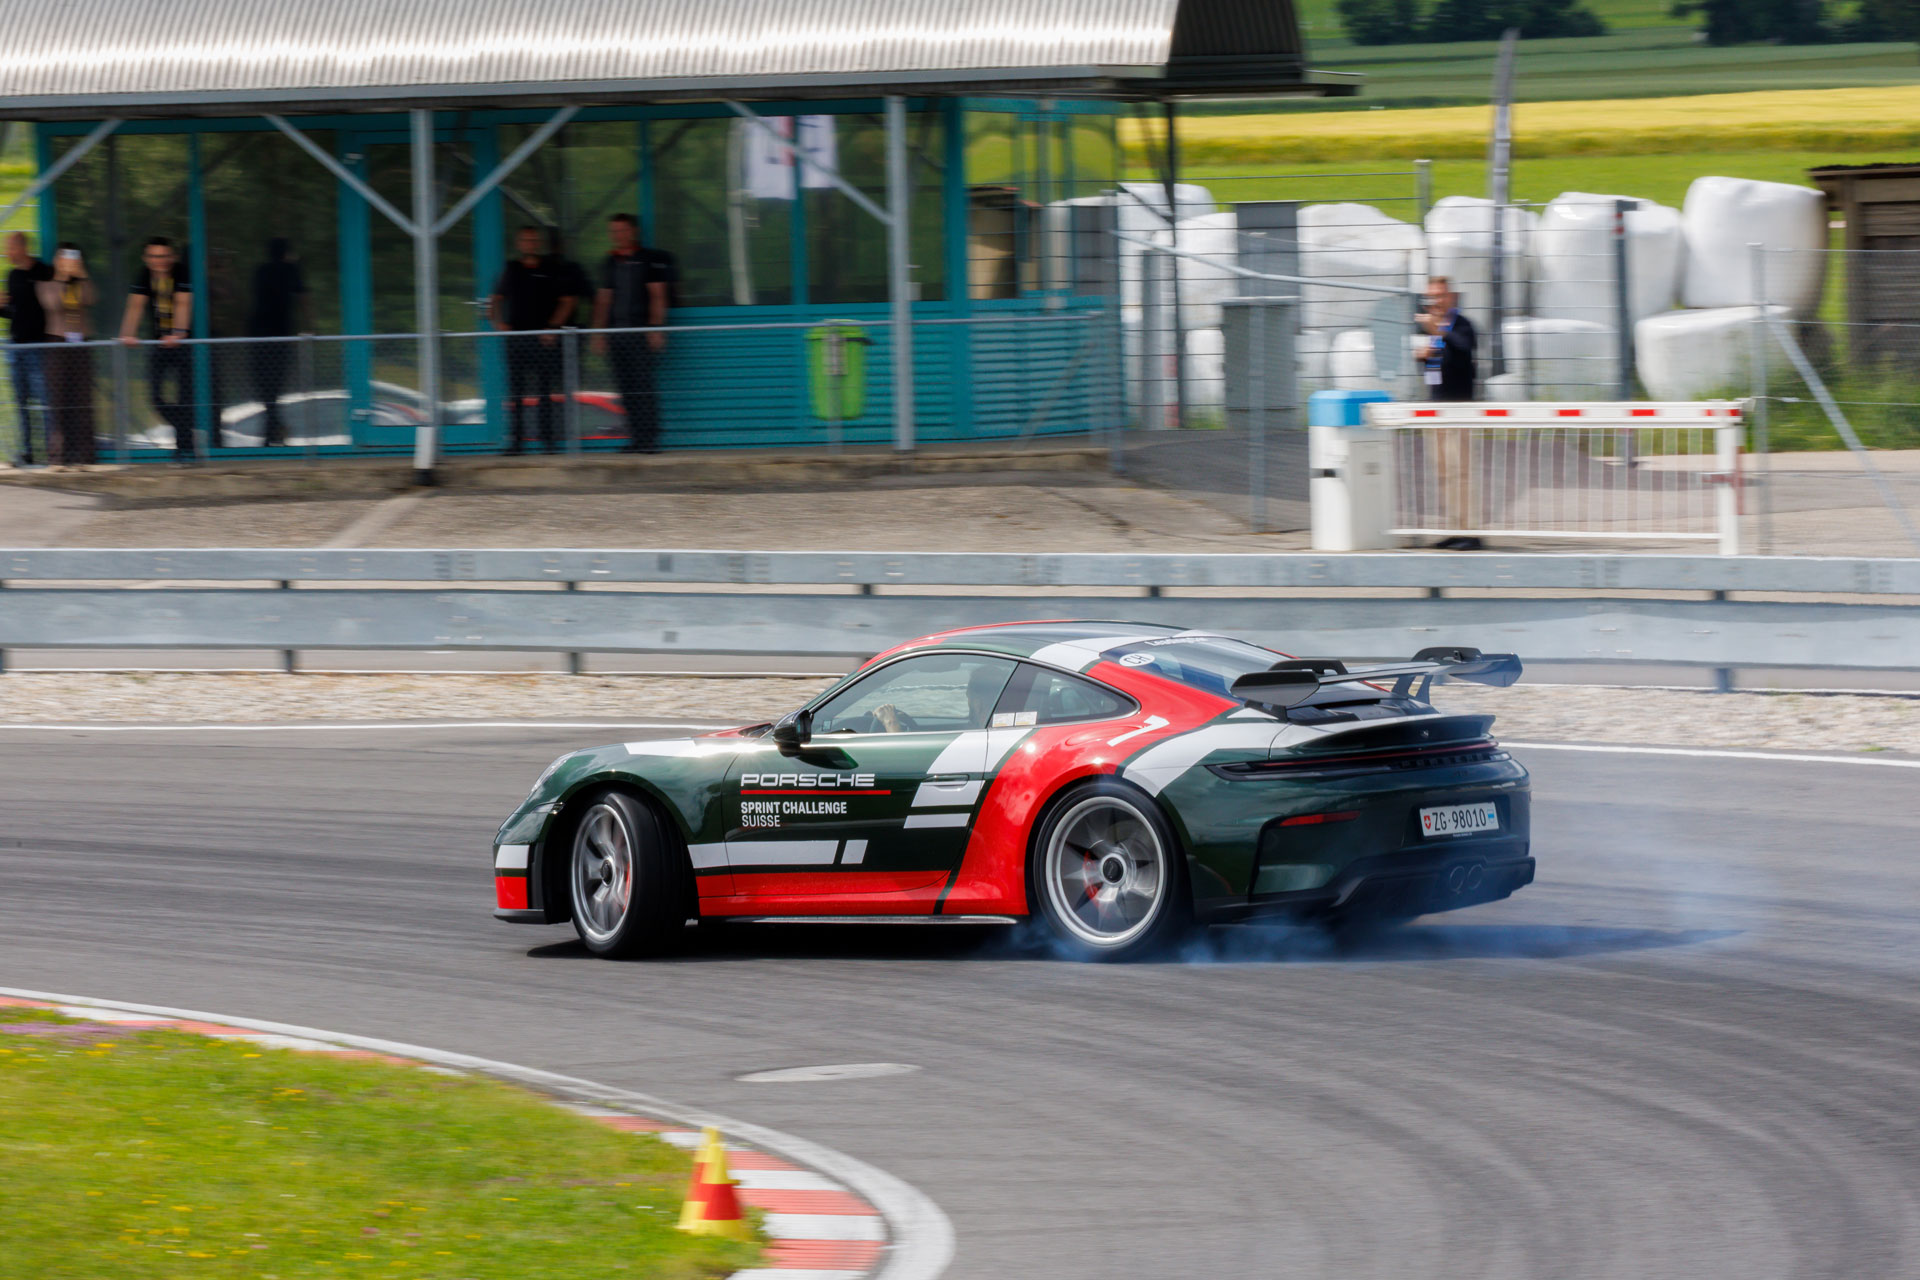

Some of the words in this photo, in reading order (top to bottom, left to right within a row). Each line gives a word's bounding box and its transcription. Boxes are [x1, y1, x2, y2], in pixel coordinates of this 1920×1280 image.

[1123, 654, 1151, 665] CH
[740, 773, 875, 787] PORSCHE
[740, 801, 781, 814] SPRINT
[782, 801, 847, 814] CHALLENGE
[741, 814, 781, 827] SUISSE
